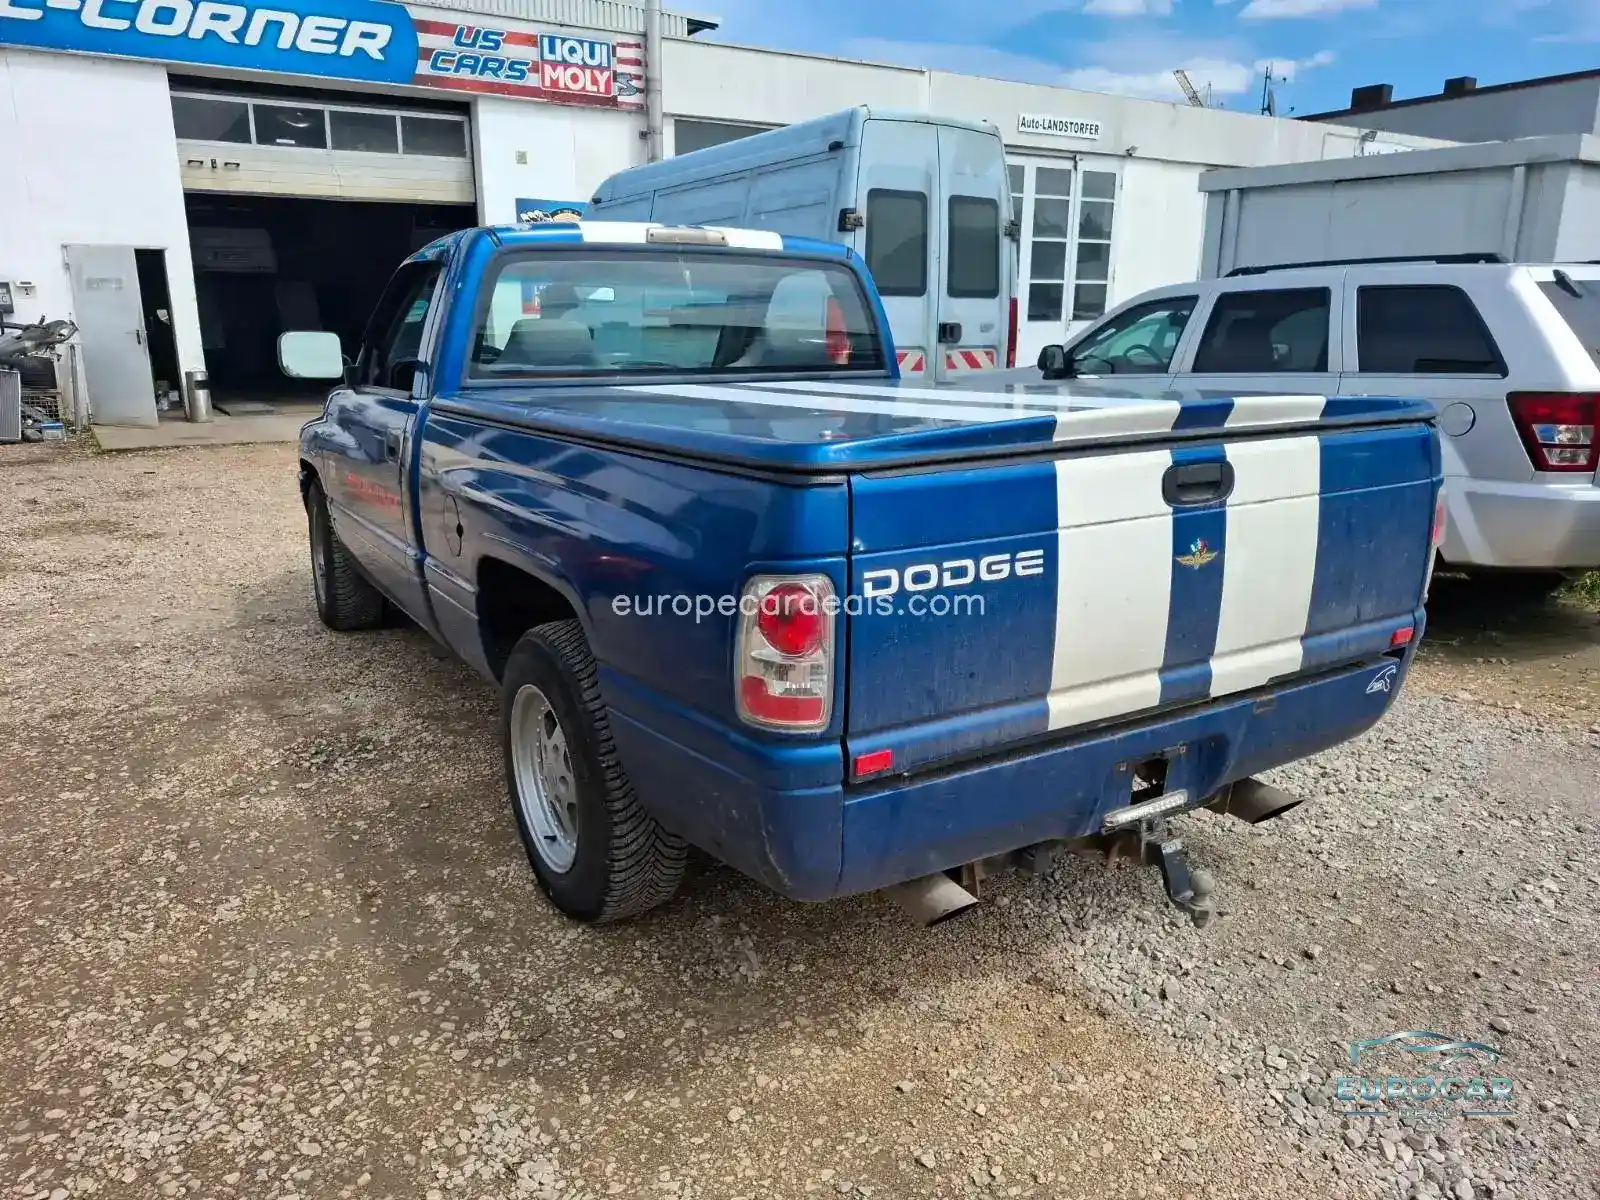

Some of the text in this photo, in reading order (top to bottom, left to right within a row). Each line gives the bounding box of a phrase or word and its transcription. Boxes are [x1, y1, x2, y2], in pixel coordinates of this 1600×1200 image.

[453, 25, 506, 51] US
[541, 36, 608, 67] LIQUI
[429, 50, 531, 82] CARS
[544, 66, 610, 94] MOLY
[1020, 116, 1099, 135] Auto-LANDSTORFER
[863, 549, 1044, 598] DODGE
